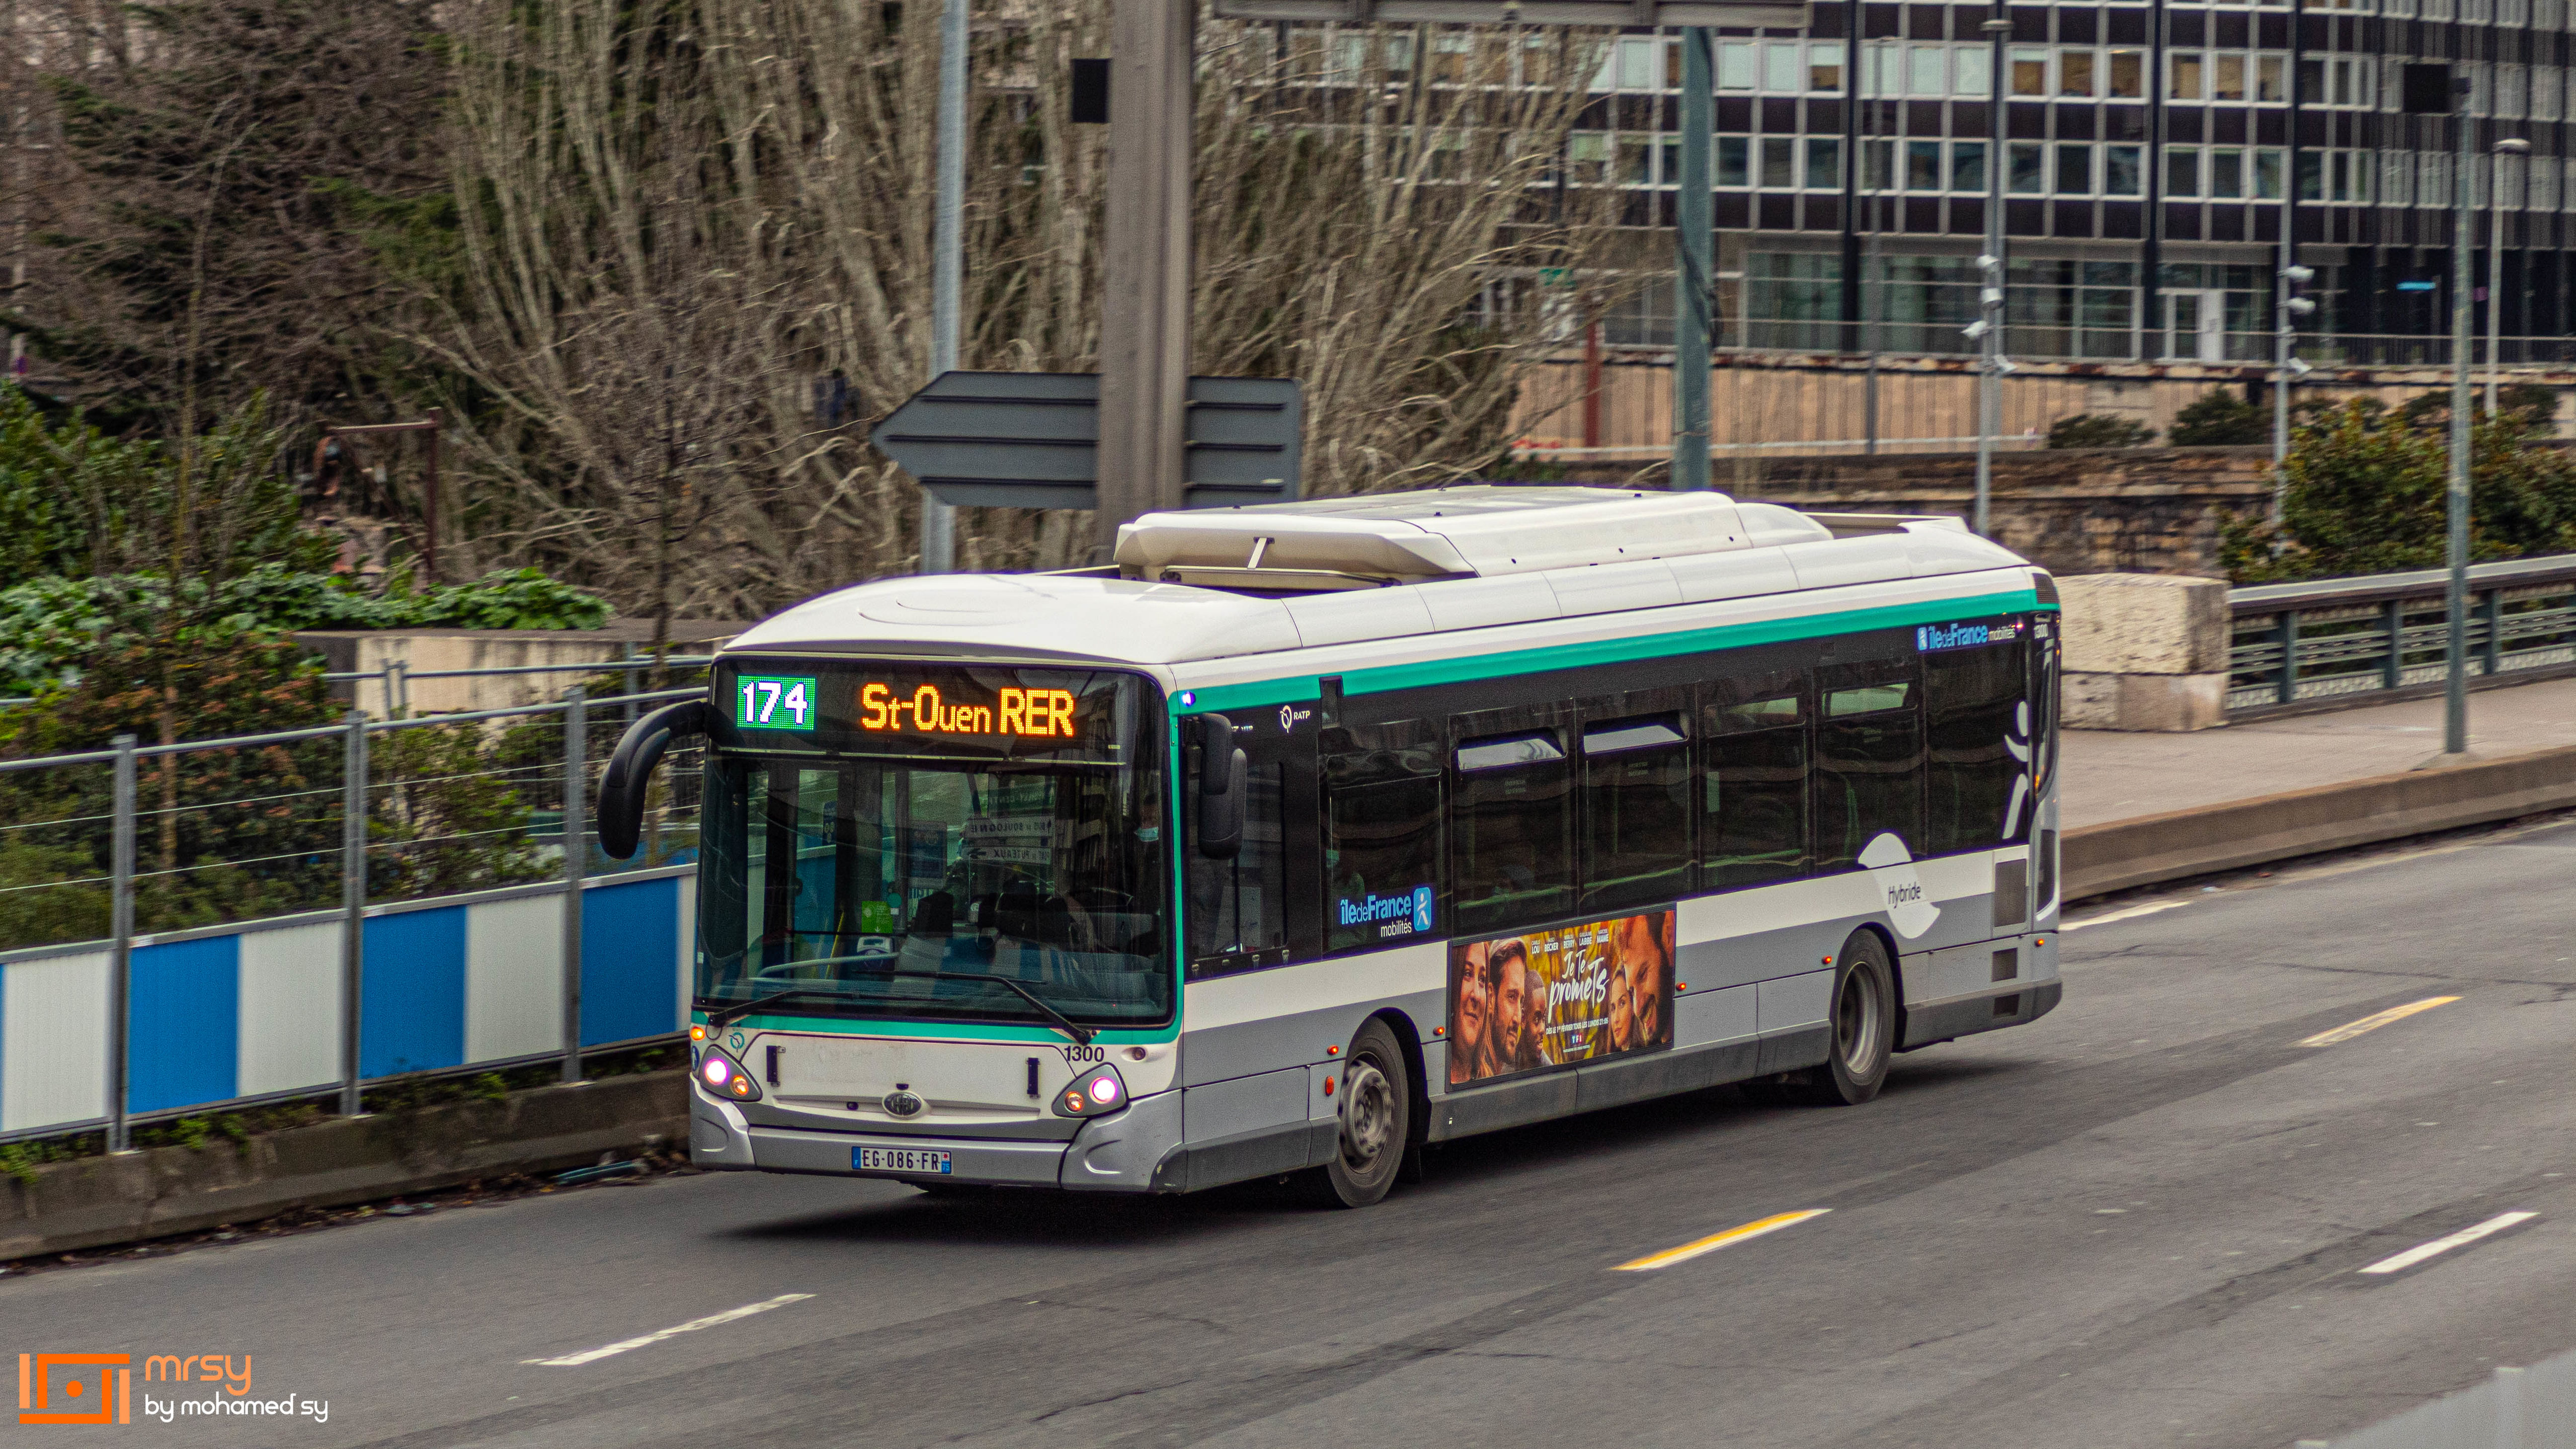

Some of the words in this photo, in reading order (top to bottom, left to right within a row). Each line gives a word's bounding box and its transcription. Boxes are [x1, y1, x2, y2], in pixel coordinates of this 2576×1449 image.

[743, 682, 809, 725] 174
[861, 683, 991, 734] St-Ouen
[999, 688, 1075, 737] RER
[1294, 710, 1310, 719] RATP
[1888, 882, 1921, 909] Hybride
[1381, 918, 1412, 937] mobilités
[1532, 945, 1540, 954] LOU
[1544, 942, 1558, 952] BECKER
[1563, 939, 1575, 949] BERRY
[1562, 951, 1575, 979] Je
[1576, 949, 1586, 980] Te
[1561, 1023, 1573, 1032] FÉVRIER
[1588, 1019, 1599, 1027] LUNDIS
[1572, 1034, 1582, 1043] TF1
[1064, 1046, 1105, 1063] 1300
[863, 1150, 939, 1170] EG-086-FR
[942, 1163, 950, 1171] 75
